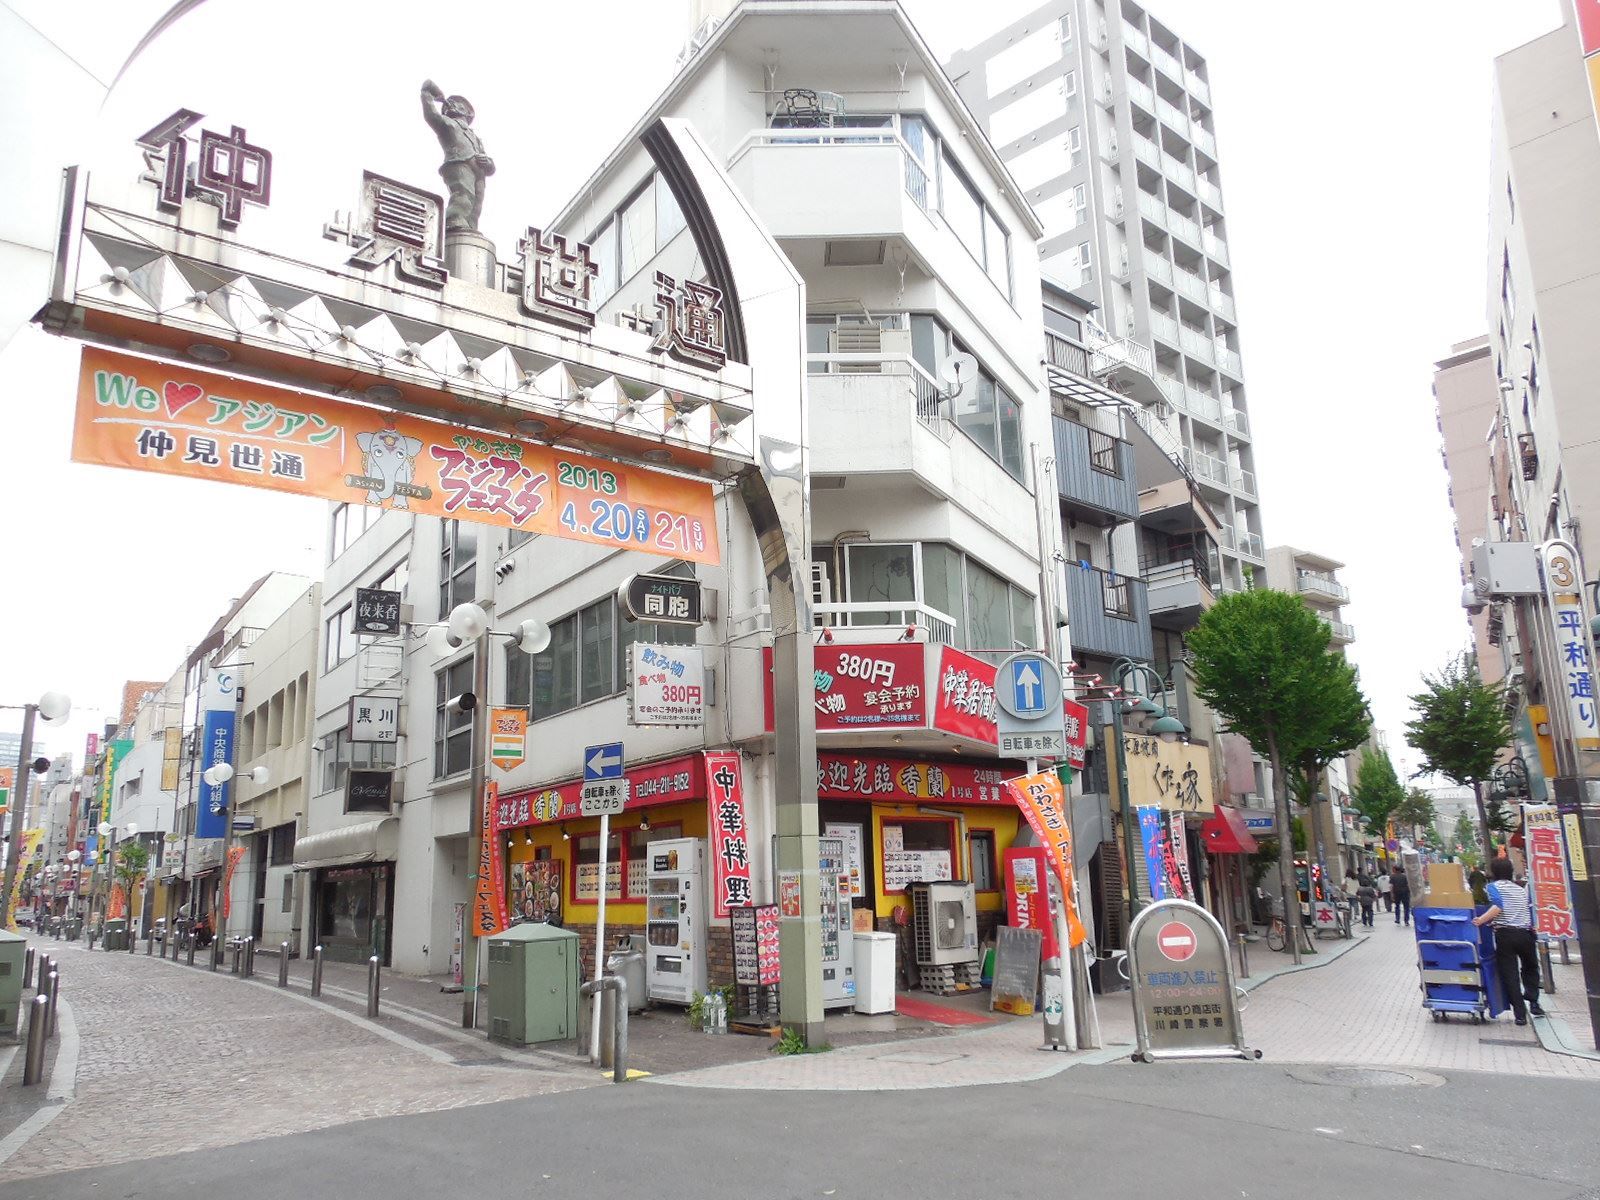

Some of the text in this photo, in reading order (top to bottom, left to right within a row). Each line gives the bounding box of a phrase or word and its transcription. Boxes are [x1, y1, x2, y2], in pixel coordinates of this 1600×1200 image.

[95, 370, 339, 444] We アジアン
[136, 428, 306, 481] 仲見世通
[452, 434, 524, 460] かわさき
[429, 444, 548, 490] アジアン
[558, 461, 617, 495] 2013
[441, 477, 546, 525] フェスタ
[560, 501, 704, 552] 4.20 SAT 21 SUN
[1551, 556, 1574, 587] 3
[651, 585, 682, 595] ナイトパブ
[359, 602, 397, 620] 夜来香
[644, 594, 689, 617] 同胞
[641, 648, 686, 678] 飲み物
[837, 653, 895, 687] 380円
[1558, 610, 1597, 729] 平和通り
[638, 673, 667, 686] 食べ物
[662, 685, 701, 705] 380円
[863, 684, 920, 706] 宴会予約
[357, 708, 394, 724] 黒川
[880, 701, 913, 714] 承ります
[1003, 736, 1061, 750] 自転車を除く
[584, 784, 621, 799] 自転車を除く
[902, 764, 944, 798] 香蘭
[585, 798, 619, 810] ここから
[714, 767, 751, 906] 中華料理
[1529, 827, 1575, 939] 高価買取
[1317, 907, 1334, 923] 本
[1147, 970, 1219, 986] 車両進入禁止
[1153, 1003, 1221, 1016] 平和通り商店街
